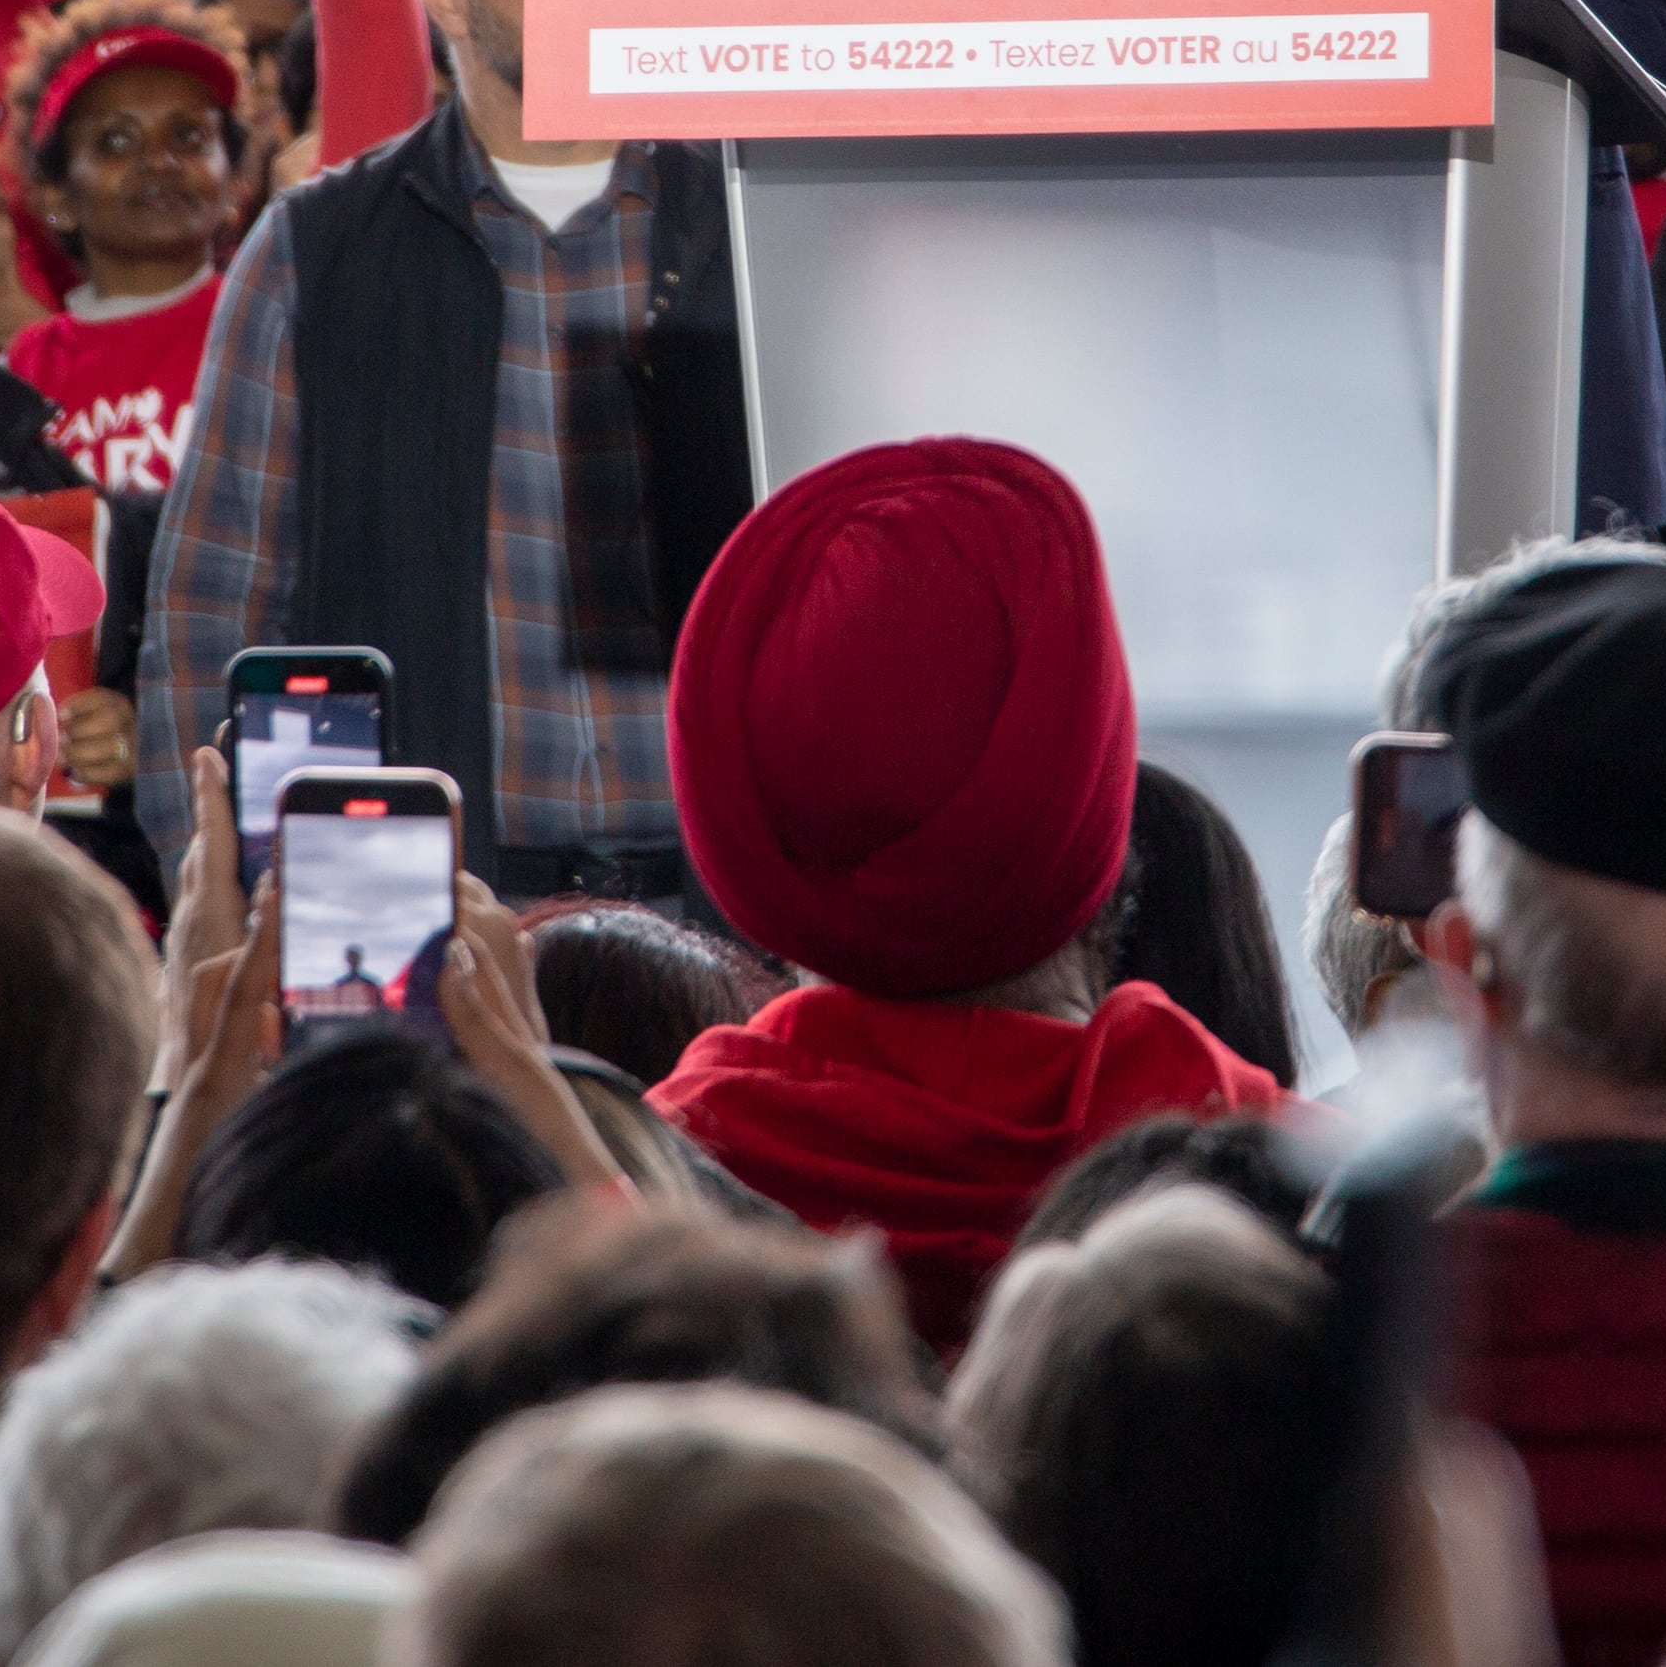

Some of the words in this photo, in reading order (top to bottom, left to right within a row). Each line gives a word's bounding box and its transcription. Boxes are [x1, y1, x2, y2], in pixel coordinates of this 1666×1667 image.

[620, 44, 688, 76] Text
[698, 43, 790, 73] VOTE
[800, 43, 836, 72] to
[847, 39, 955, 71] 54222
[988, 38, 1096, 69] Textez
[1106, 34, 1222, 66] VOTER
[1232, 37, 1278, 64] au
[1290, 29, 1398, 62] 54222
